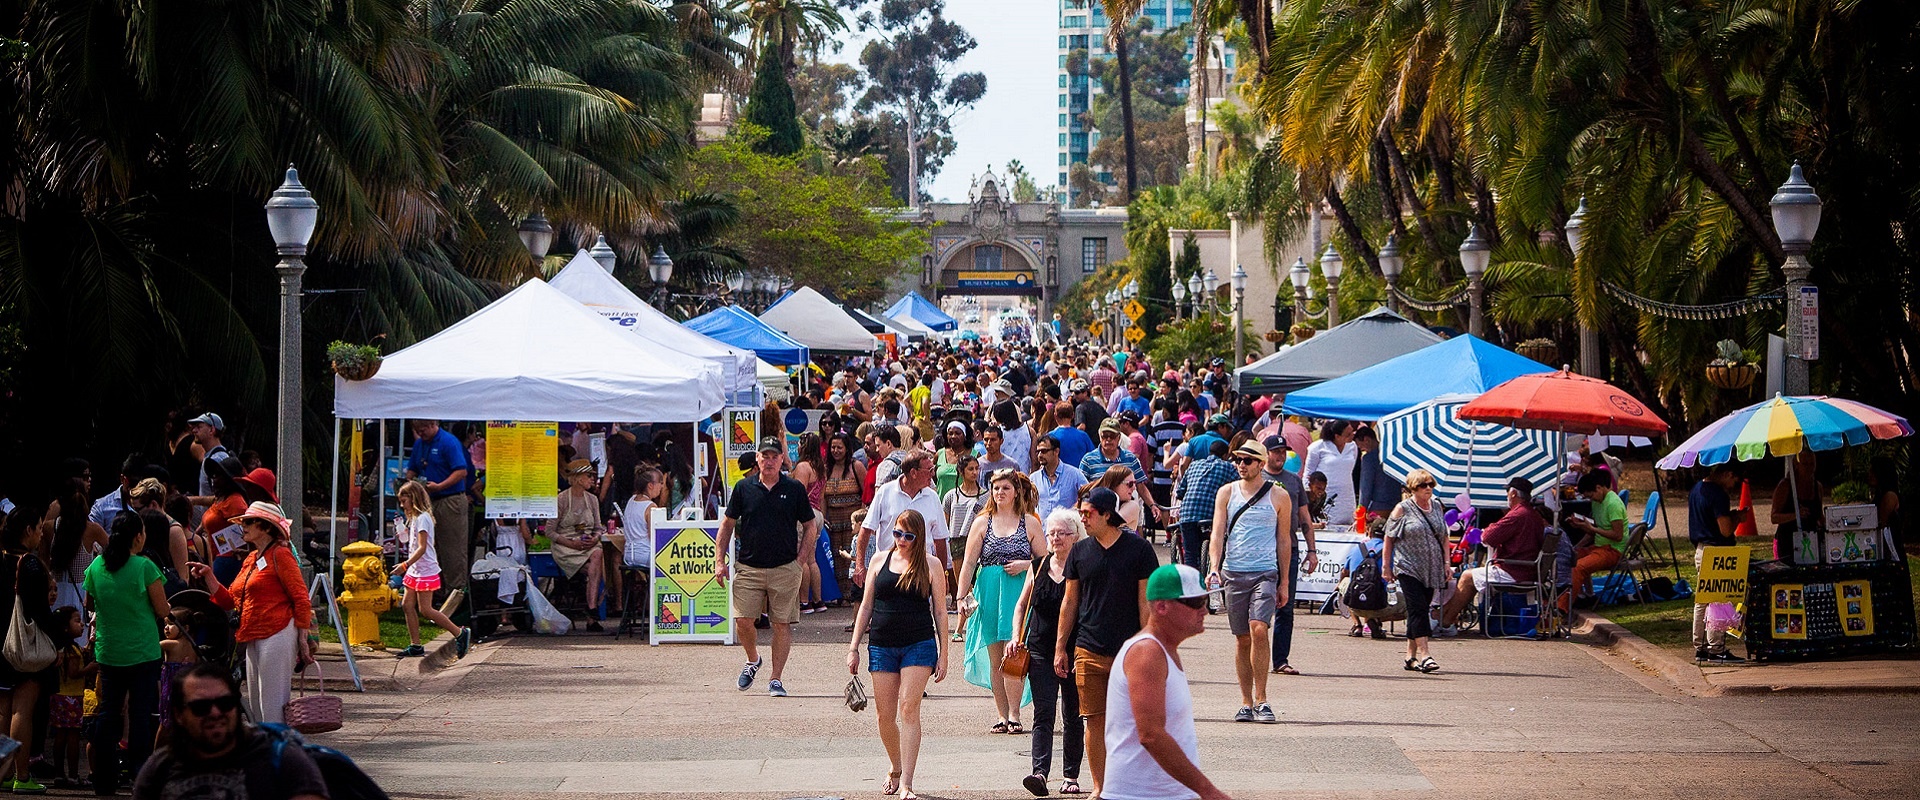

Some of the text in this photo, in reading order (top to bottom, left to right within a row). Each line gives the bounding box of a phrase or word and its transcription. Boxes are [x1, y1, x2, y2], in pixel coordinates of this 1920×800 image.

[735, 411, 755, 421] ART
[730, 443, 756, 451] STUDIOS
[670, 542, 715, 559] Artists
[669, 560, 716, 575] at Work!
[1712, 556, 1738, 570] FACE
[1698, 578, 1745, 593] PAINTING
[663, 594, 681, 603] ART
